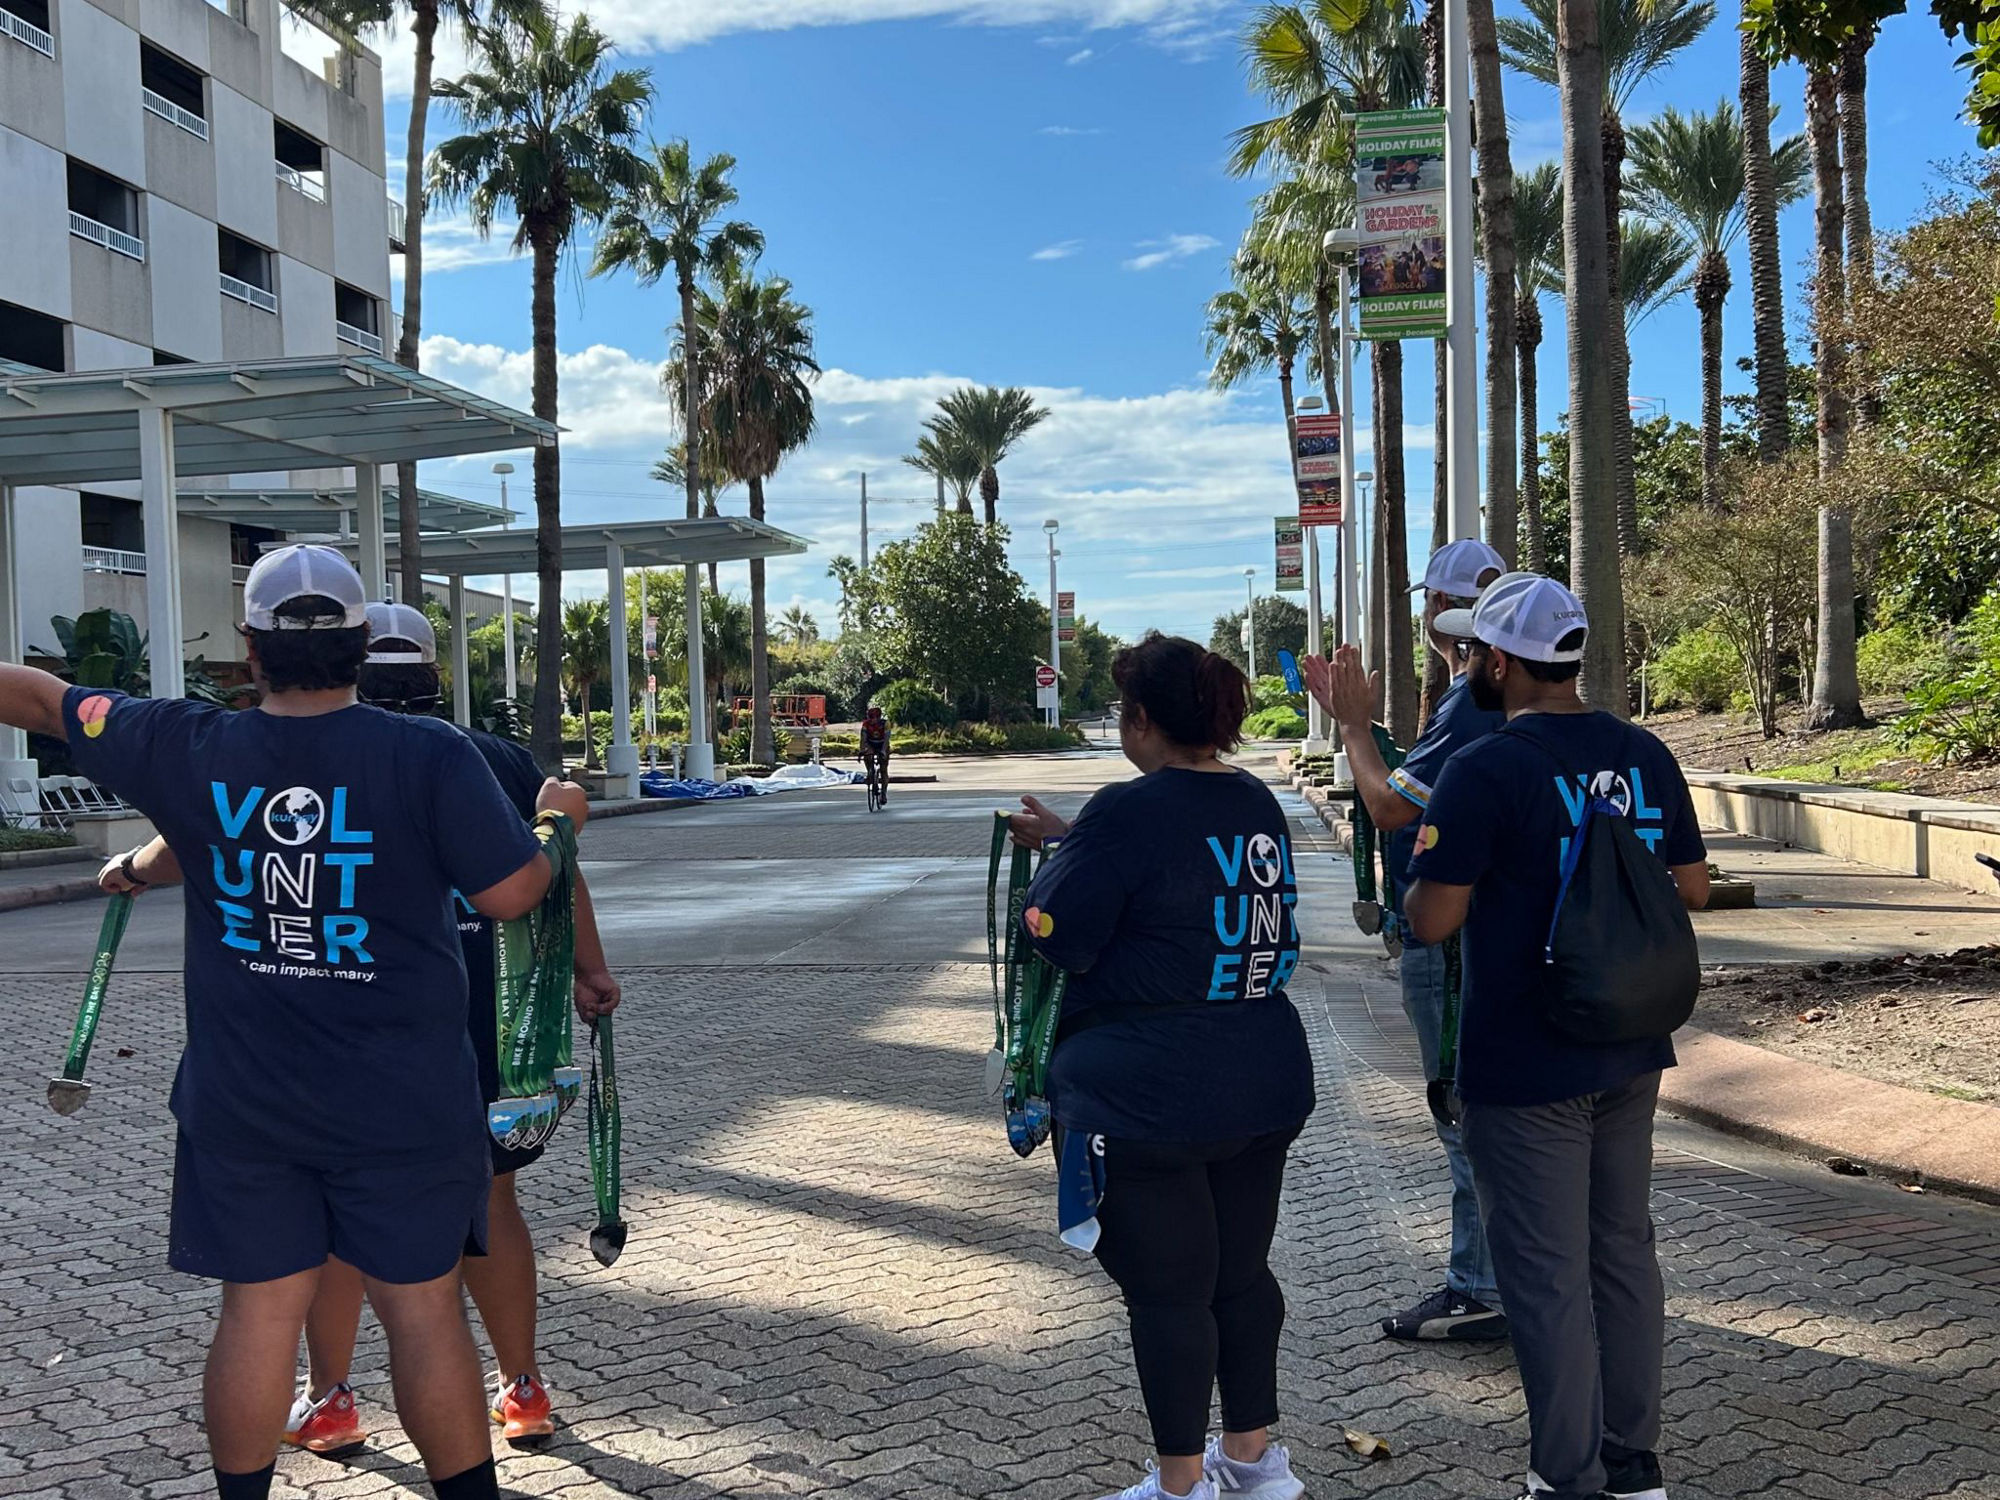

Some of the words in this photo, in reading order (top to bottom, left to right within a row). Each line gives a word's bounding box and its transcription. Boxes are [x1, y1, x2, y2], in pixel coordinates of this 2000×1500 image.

[1357, 140, 1407, 153] HOLIDAY
[1409, 137, 1443, 149] FILMS
[1364, 204, 1425, 220] HOLIDAY
[1365, 215, 1439, 233] GARDENS
[1361, 300, 1411, 313] HOLIDAY
[1412, 299, 1445, 311] FILMS
[211, 781, 373, 846] VOL
[1206, 833, 1297, 888] VOL
[208, 845, 374, 908] UNT
[1214, 893, 1301, 947] UNT
[215, 900, 375, 965] EER
[497, 936, 508, 978] AROUND
[249, 961, 276, 975] can
[280, 962, 331, 979] impact
[333, 969, 377, 983] many.
[529, 966, 542, 985] BAY
[1206, 949, 1299, 1001] EER
[500, 979, 509, 996] THE
[528, 987, 537, 1003] THE
[1051, 985, 1061, 1001] THE
[502, 998, 510, 1018] BAY
[1013, 983, 1024, 1022] AROUND
[516, 1005, 534, 1046] AROUND
[1012, 1024, 1022, 1041] THE
[1042, 1003, 1058, 1043] AROUND
[512, 1046, 523, 1066] BIKE
[1039, 1043, 1049, 1065] BIKE
[605, 1076, 614, 1110] 2025
